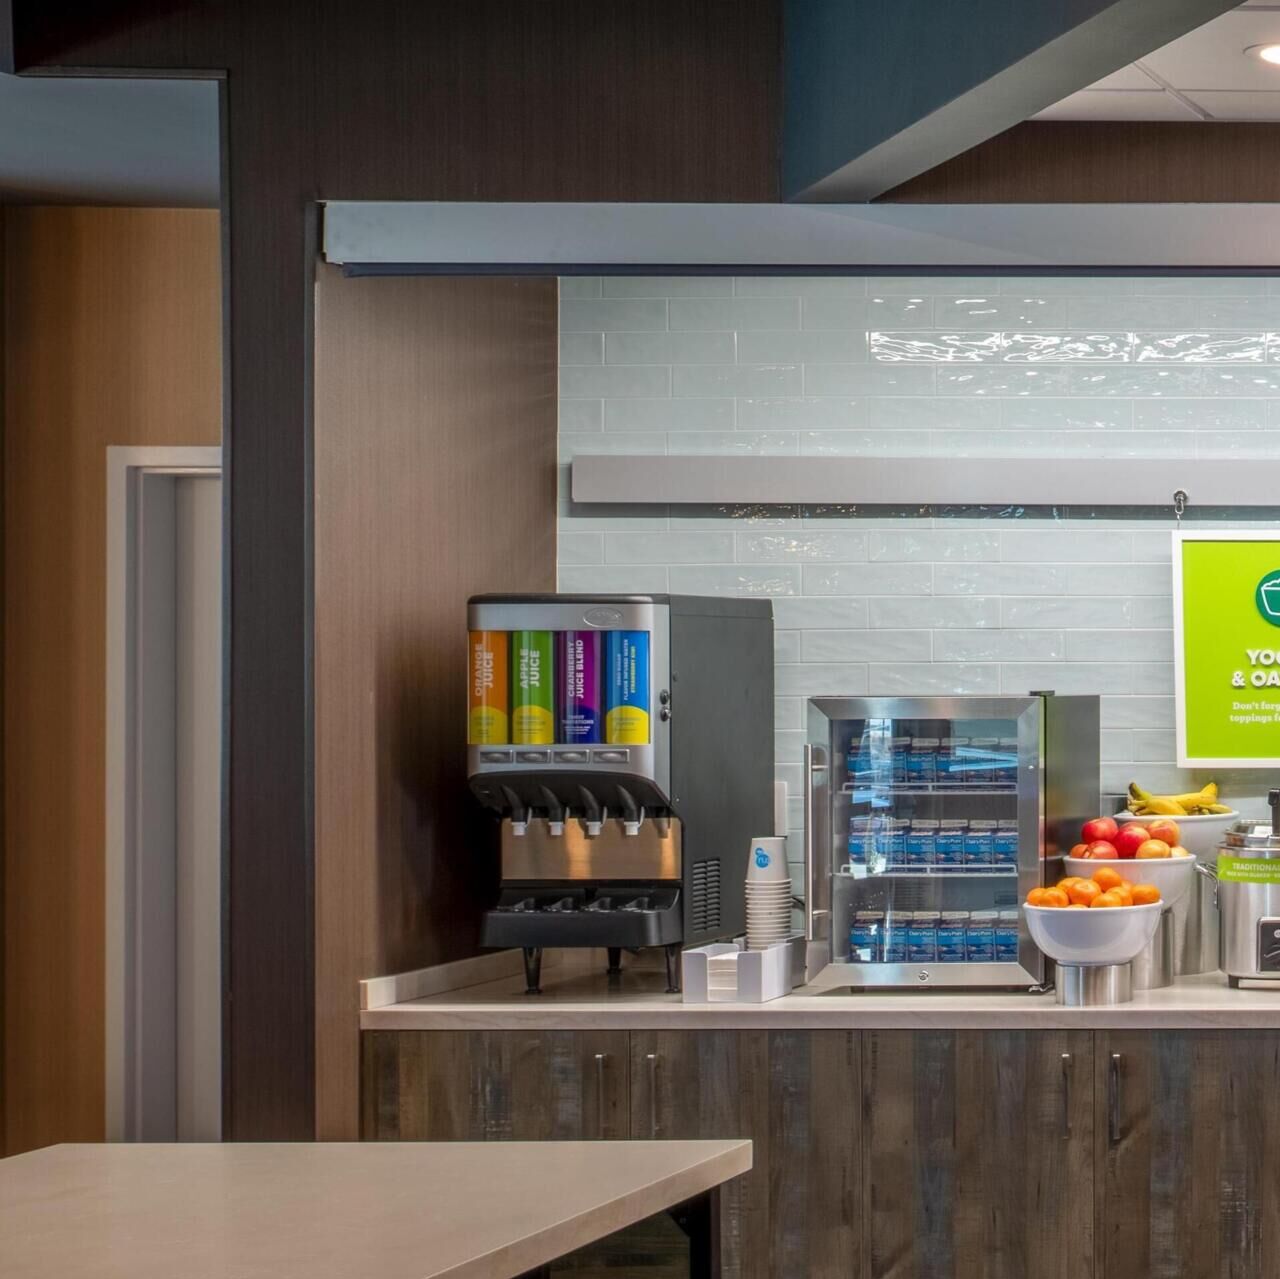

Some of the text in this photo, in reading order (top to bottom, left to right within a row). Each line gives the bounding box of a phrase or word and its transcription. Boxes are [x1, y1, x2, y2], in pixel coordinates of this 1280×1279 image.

[474, 643, 484, 697] ORANGE
[483, 651, 494, 689] JUICE
[519, 648, 529, 689] APPLE
[530, 649, 540, 688] JUICE
[567, 641, 575, 697] CRANBERRY
[576, 639, 584, 699] JUICE BLEND
[1231, 671, 1246, 687] &
[1230, 714, 1272, 724] toppings
[1232, 701, 1259, 710] Don't
